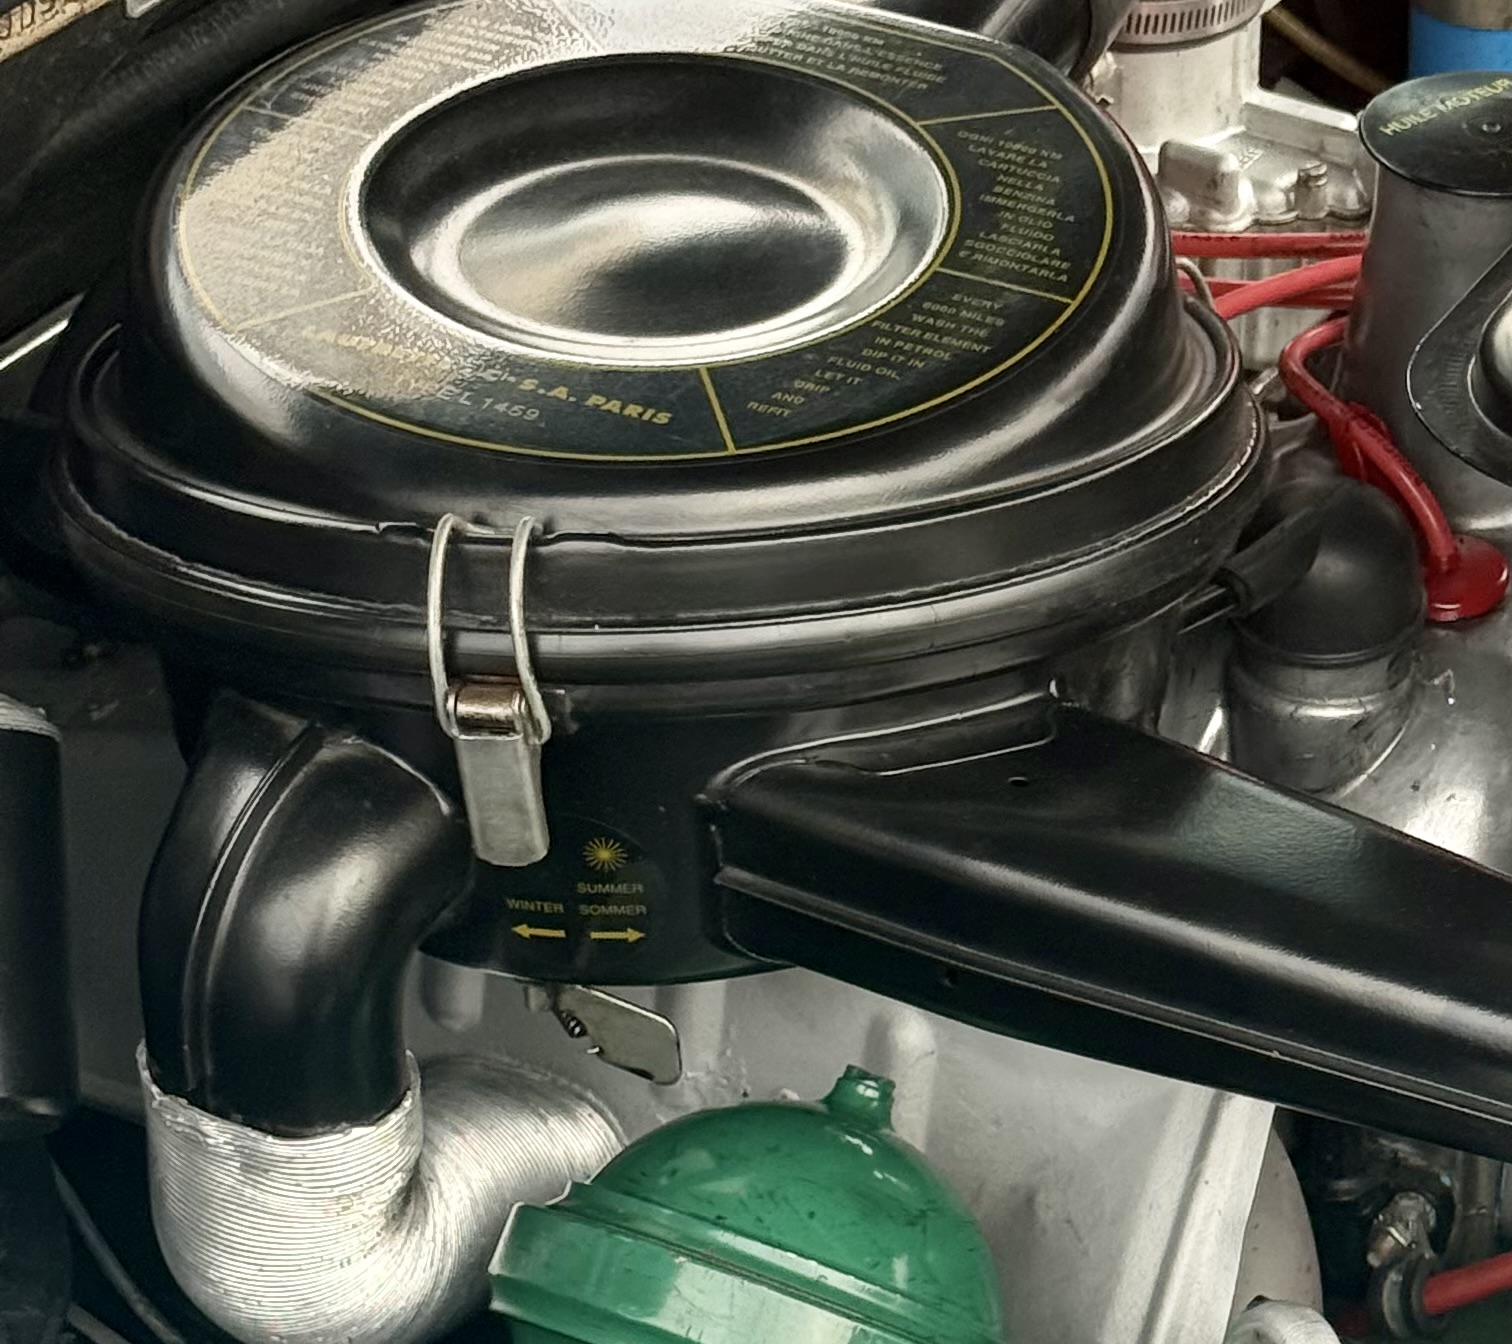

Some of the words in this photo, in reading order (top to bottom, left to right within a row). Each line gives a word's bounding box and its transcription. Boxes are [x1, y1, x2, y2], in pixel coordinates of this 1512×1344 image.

[1378, 107, 1438, 137] HUILE
[968, 143, 1025, 164] LAVARE
[1028, 157, 1048, 169] LA
[977, 158, 1061, 184] CARTUCCIA
[996, 174, 1045, 192] NELLA
[992, 185, 1056, 206] BENZINA
[978, 193, 1076, 223] IMMERGERLA
[999, 211, 1015, 220] IN
[1017, 215, 1054, 230] OLIO
[1000, 222, 1056, 242] FLUIDO
[963, 238, 1073, 271] SGOCCIOLARE
[978, 230, 1062, 257] LASCIARLA
[972, 254, 1069, 283] RIMONTARLA
[952, 292, 1004, 311] EVERY
[911, 312, 957, 330] WASH
[960, 326, 990, 339] THE
[921, 301, 957, 316] 6000
[958, 309, 1006, 327] MILES
[872, 319, 922, 341] FILTER
[921, 331, 992, 355] ELEMENT
[874, 335, 891, 347] IN
[892, 339, 952, 362] PETROL
[826, 356, 873, 373] FLUID
[861, 347, 888, 360] DIP
[889, 353, 906, 364] IT
[907, 358, 927, 370] IN
[815, 369, 844, 382] LET
[846, 374, 866, 386] IT
[517, 377, 578, 403] S.A.
[584, 393, 674, 426] PARIS
[770, 390, 806, 405] AND
[746, 401, 794, 418] REFIT
[576, 882, 644, 895] SUMMER
[505, 898, 565, 914] WINTER
[578, 904, 648, 917] SOMMER
